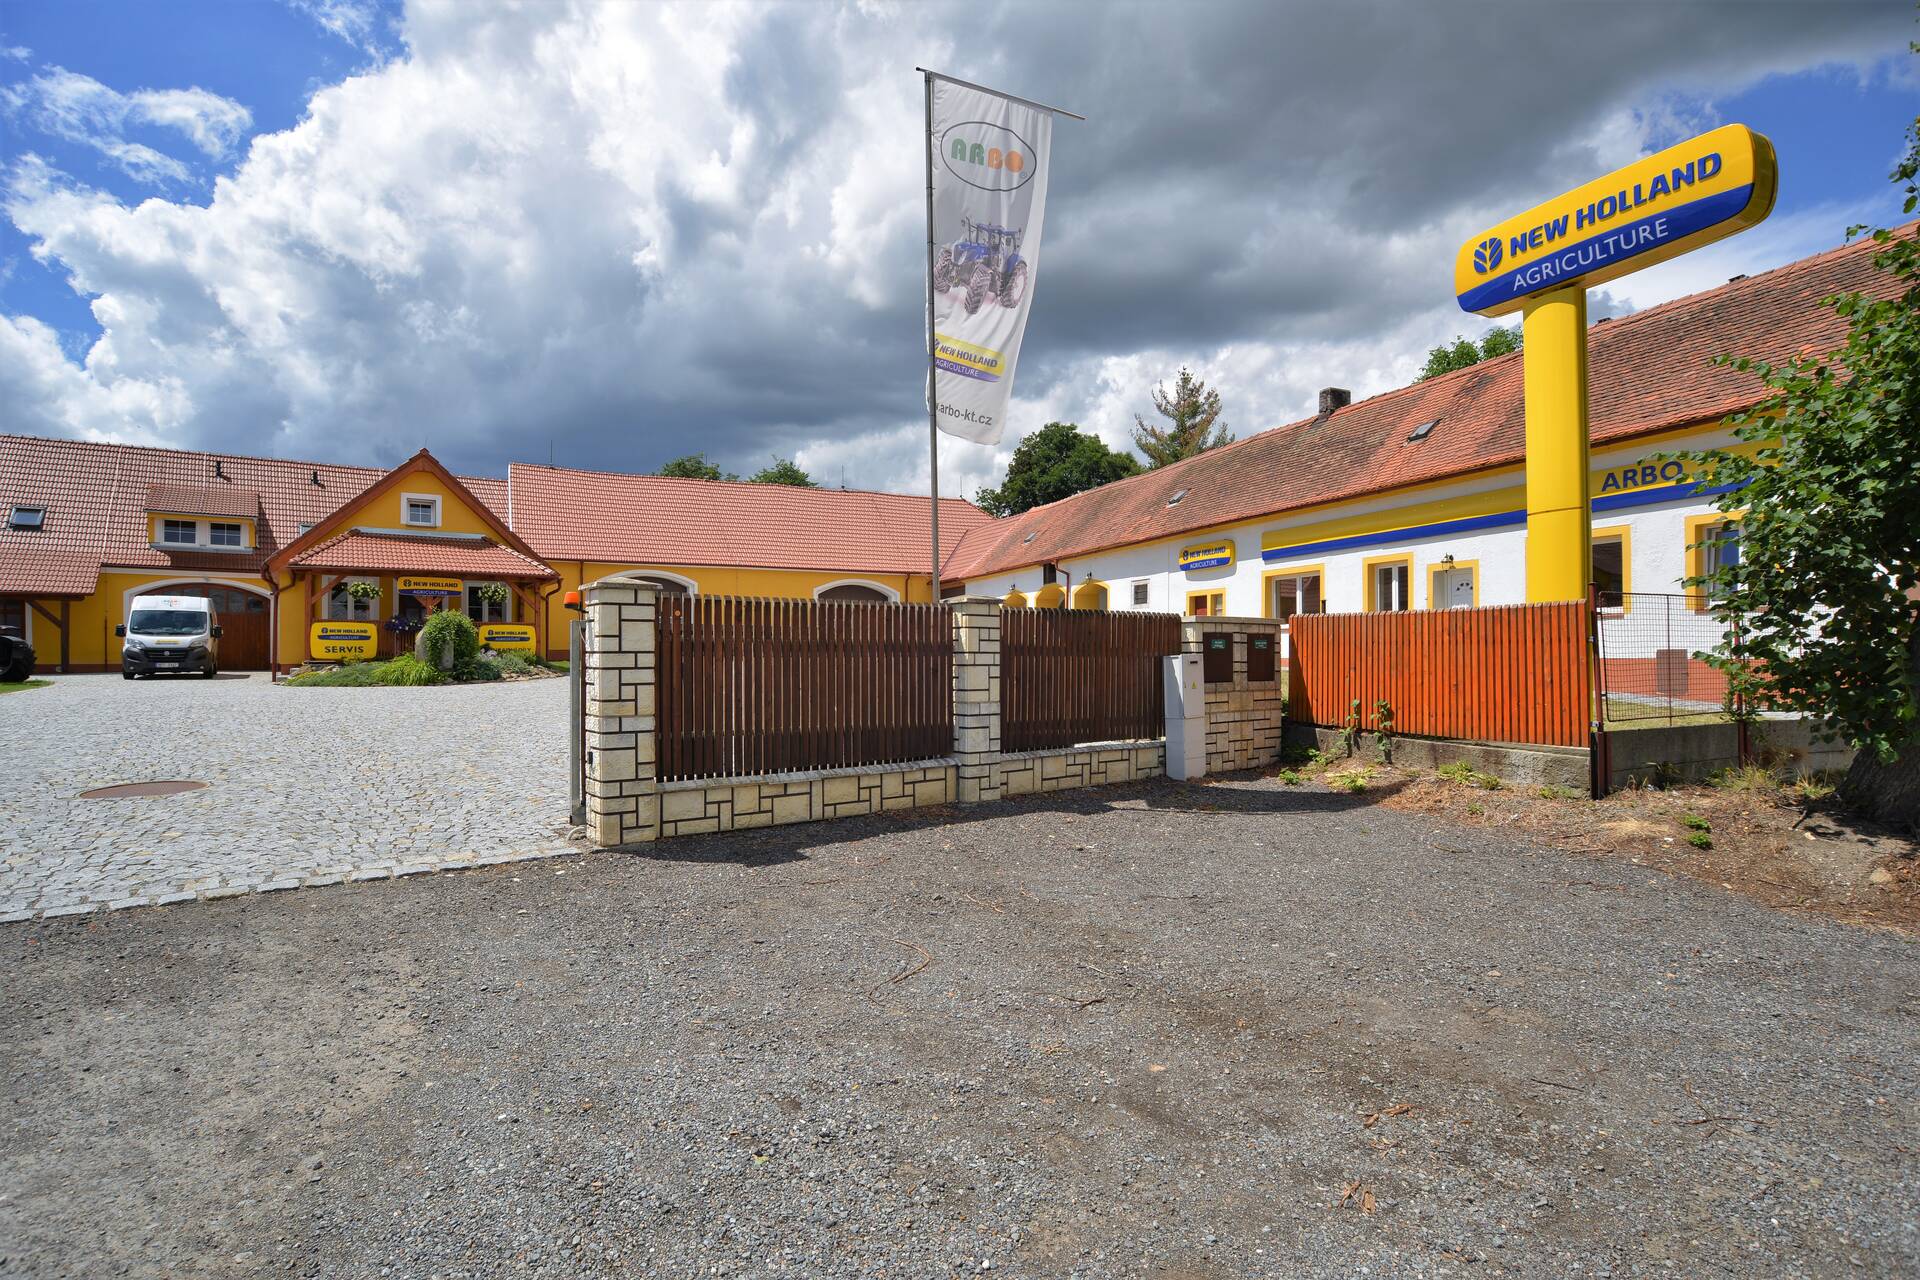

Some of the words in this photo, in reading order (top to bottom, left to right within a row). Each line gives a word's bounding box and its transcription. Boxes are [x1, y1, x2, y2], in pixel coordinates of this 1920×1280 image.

[951, 138, 1024, 173] ARBO
[1510, 214, 1569, 256] NEW
[1576, 152, 1722, 230] HOLLAND
[1513, 217, 1669, 291] AGRICULTURE
[936, 359, 980, 377] AGRICULTURE
[940, 345, 956, 356] NEW
[956, 350, 998, 368] HOLLAND
[1601, 461, 1683, 492] ARBO
[324, 645, 365, 654] SERVIS
